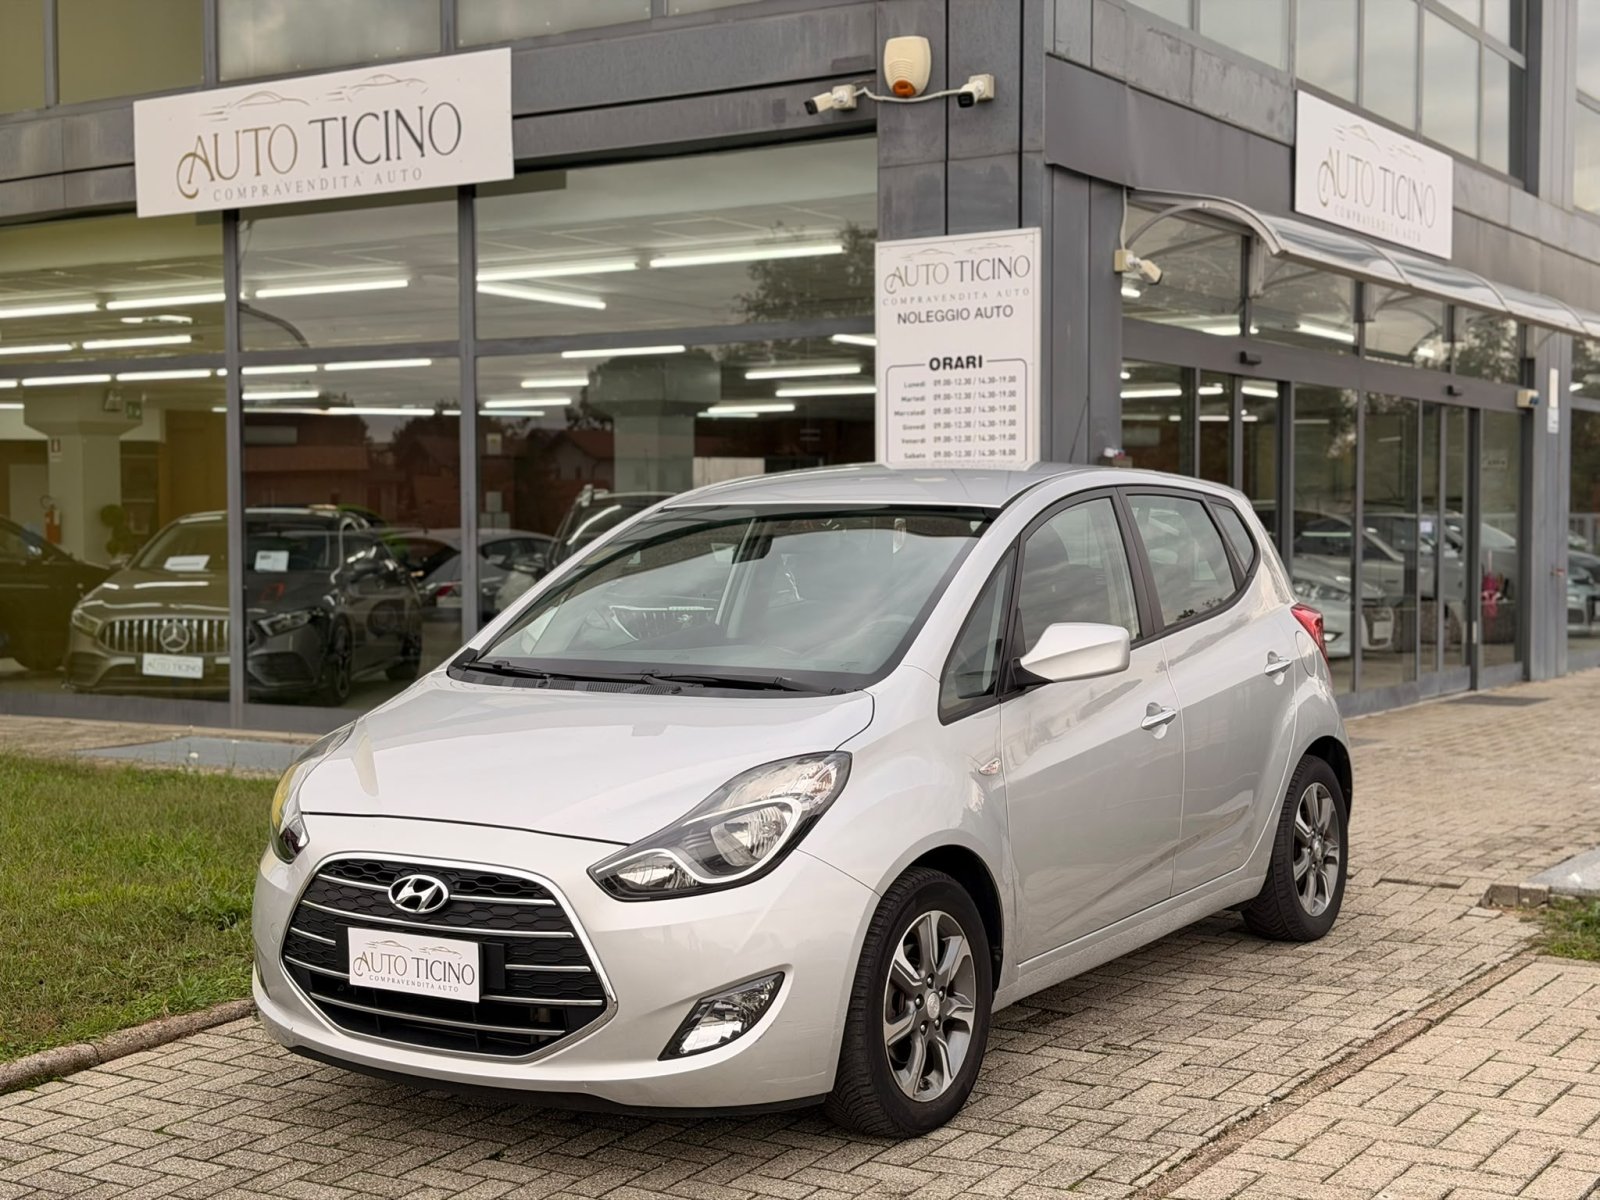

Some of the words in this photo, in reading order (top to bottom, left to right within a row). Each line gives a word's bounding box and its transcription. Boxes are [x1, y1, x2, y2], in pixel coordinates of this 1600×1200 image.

[176, 123, 298, 199] AUTO
[308, 101, 462, 169] TICINO
[213, 174, 362, 202] COMPRAVENDITA
[374, 167, 423, 185] AUTO
[1317, 147, 1375, 207] AUTO
[1379, 166, 1436, 228] TICINO
[884, 262, 949, 294] AUTO
[954, 255, 1031, 282] TICINO
[882, 290, 988, 306] COMPRAVENDITA
[997, 288, 1030, 298] AUTO
[897, 307, 970, 325] NOLEGGIO
[974, 304, 1014, 319] AUTO
[929, 355, 983, 371] ORARI
[353, 951, 407, 976] AUTO
[411, 957, 475, 985] TICINO
[369, 974, 435, 990] COMPRAVENDITA
[438, 984, 459, 993] AUTO
